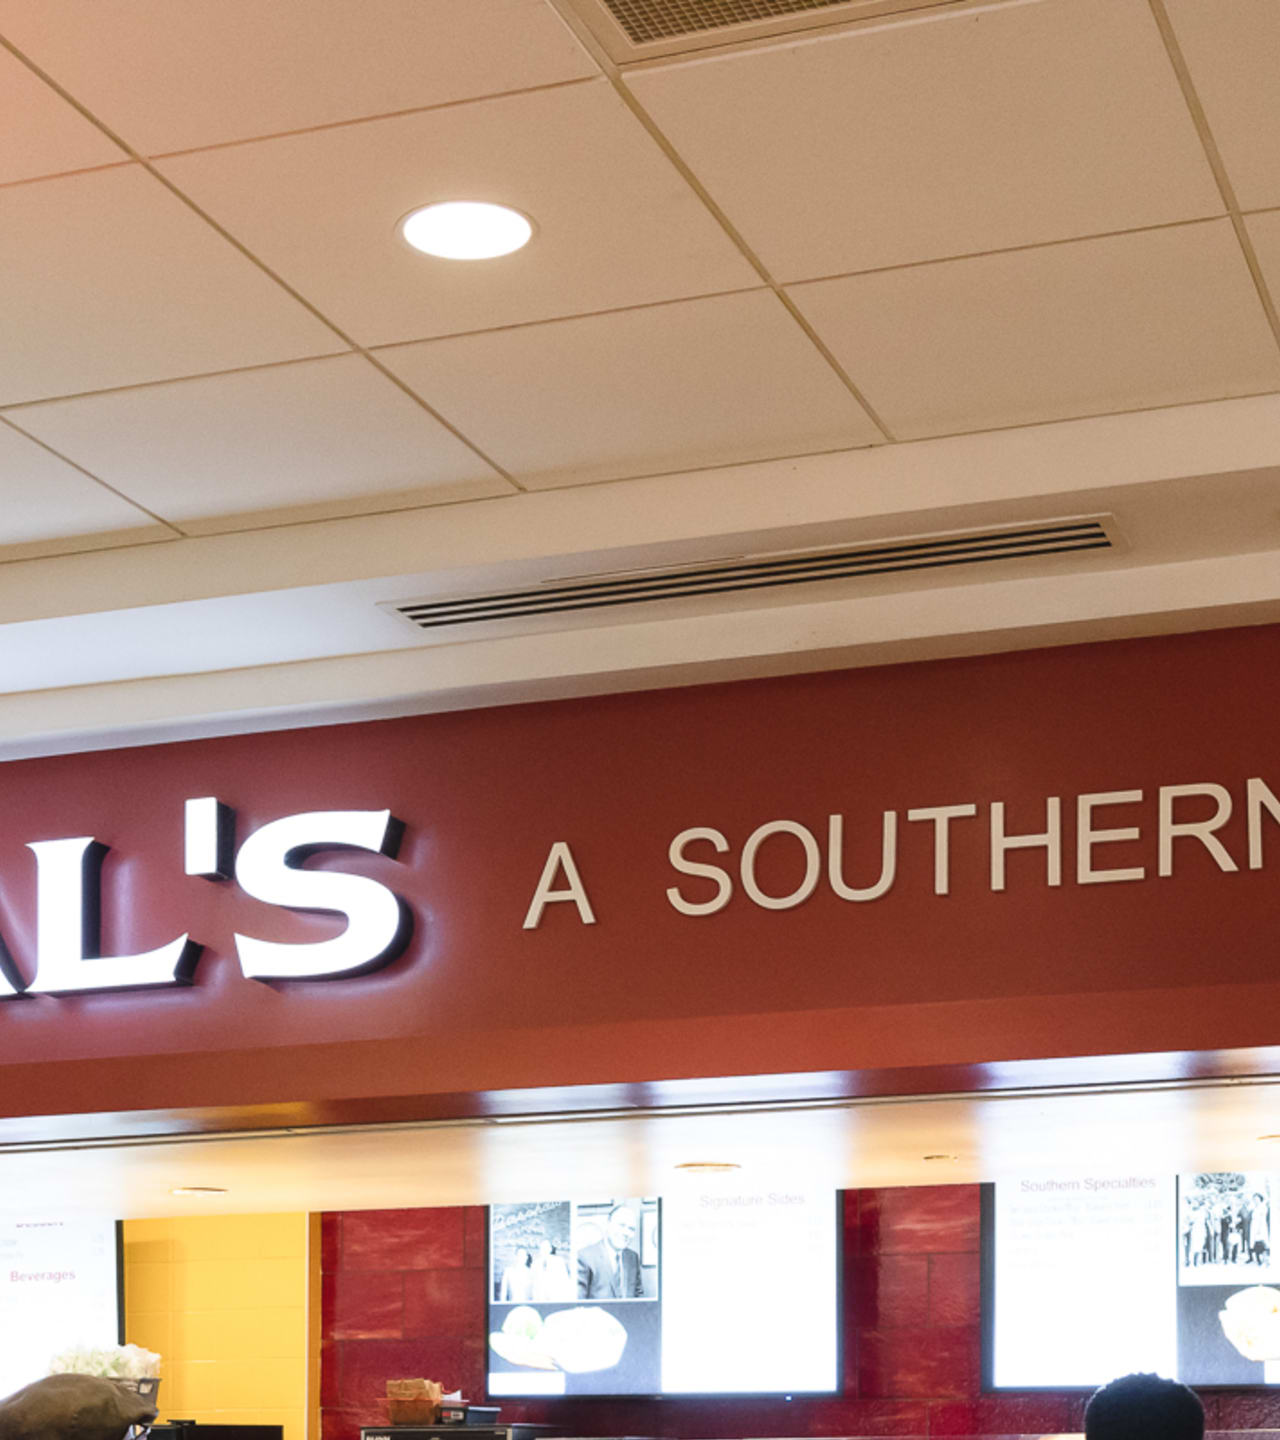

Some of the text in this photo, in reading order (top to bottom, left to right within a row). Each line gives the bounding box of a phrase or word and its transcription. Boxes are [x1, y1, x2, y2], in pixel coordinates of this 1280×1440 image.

[522, 841, 596, 929] A
[1020, 1177, 1157, 1193] Southern Specialties
[699, 1195, 764, 1210] Signature
[9, 1270, 76, 1284] Beverages
